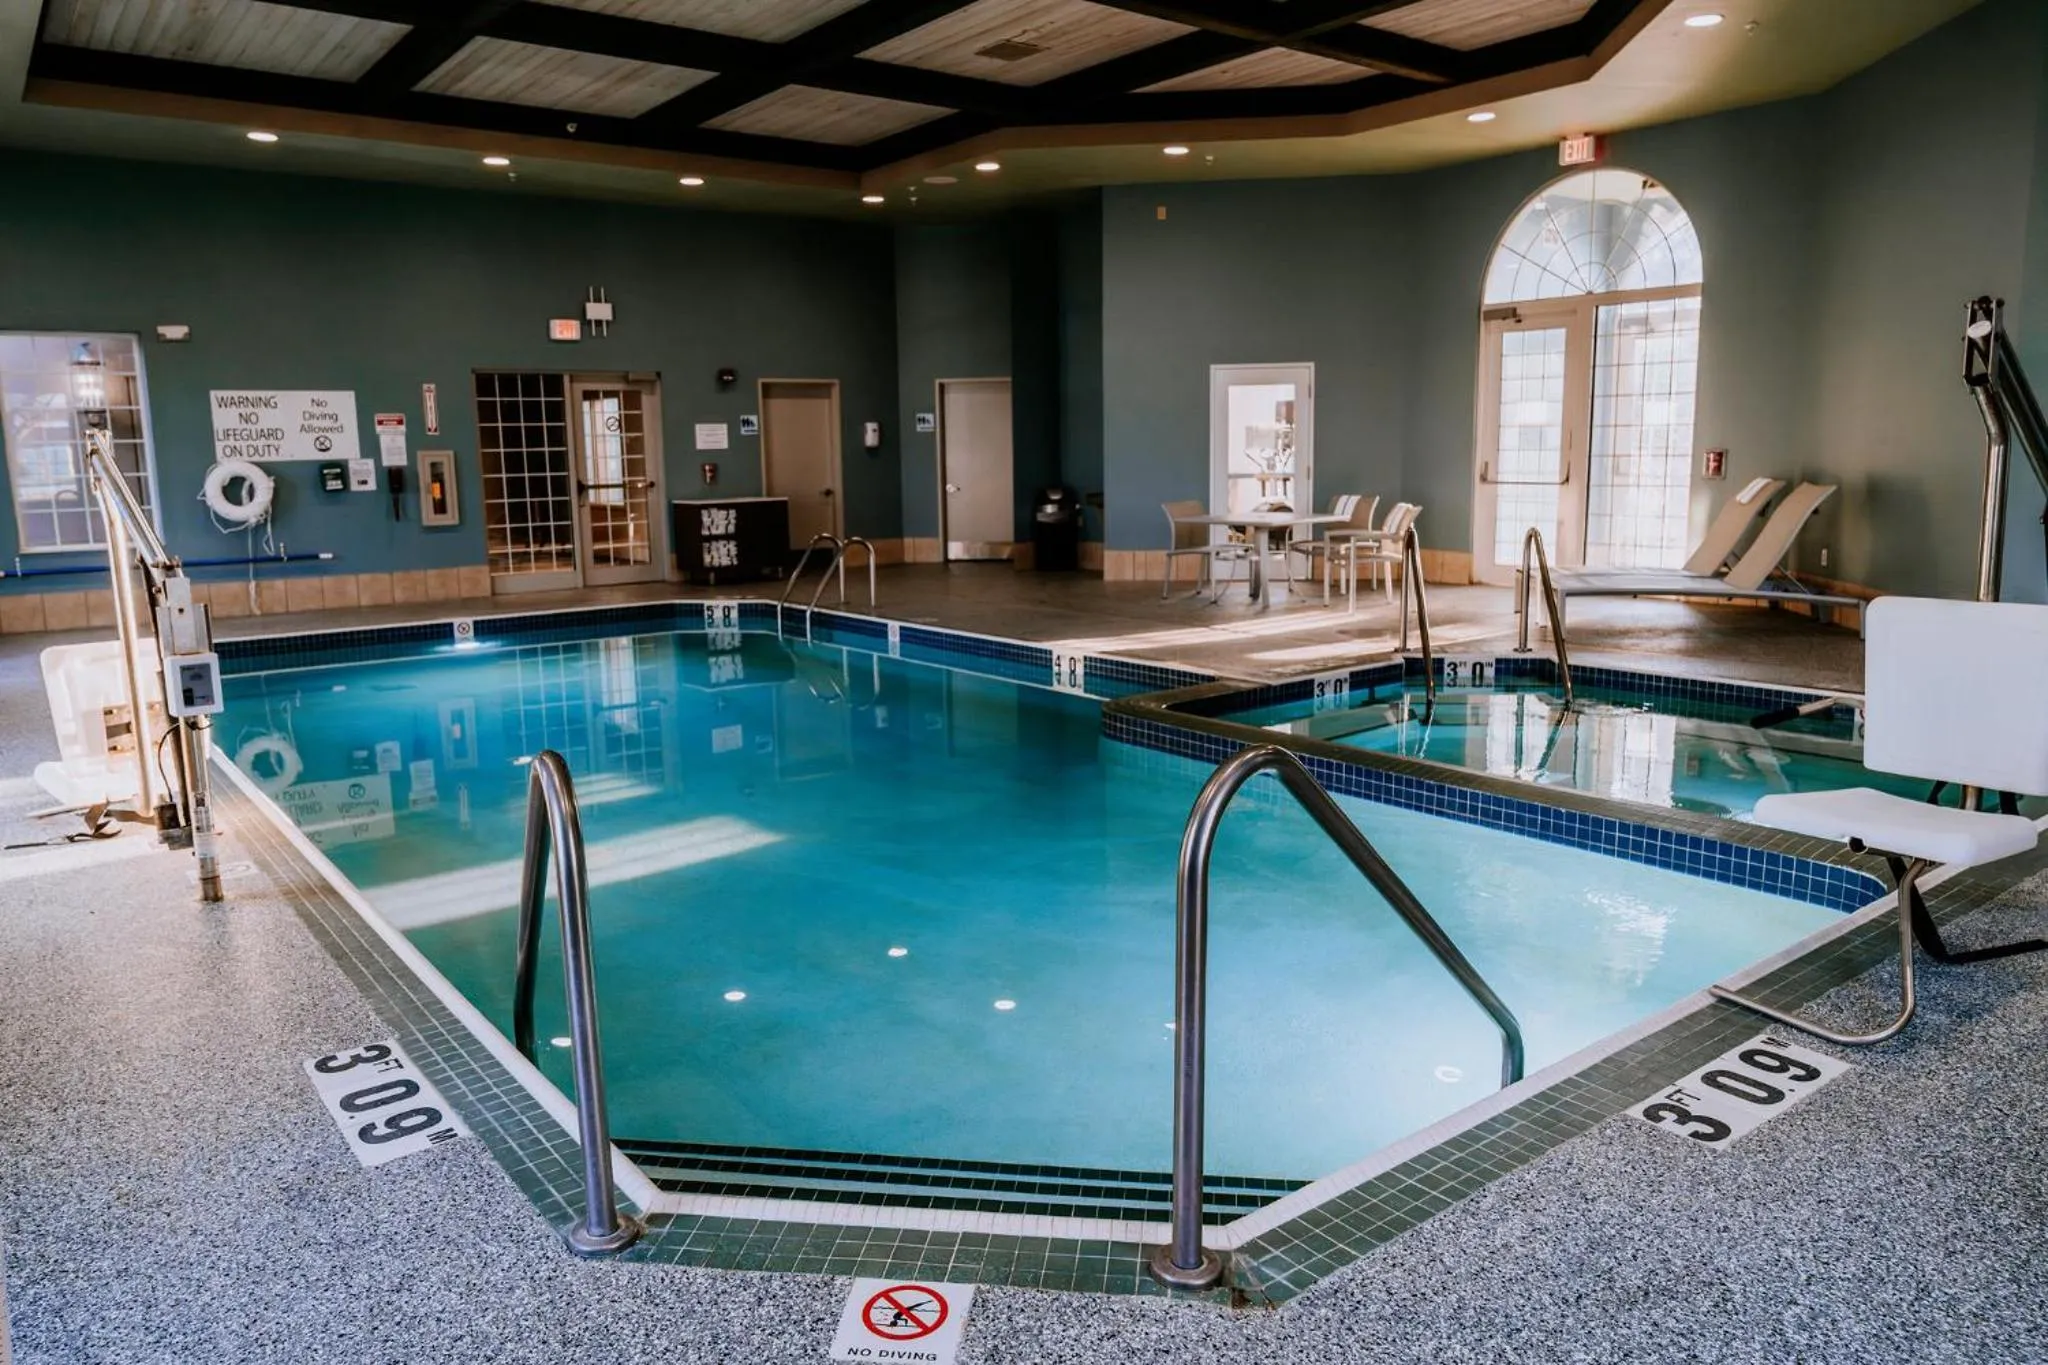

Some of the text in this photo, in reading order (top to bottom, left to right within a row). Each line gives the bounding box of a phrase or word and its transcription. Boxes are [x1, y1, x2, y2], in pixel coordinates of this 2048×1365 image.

[1565, 139, 1588, 161] EXIT
[214, 394, 278, 409] WARNING
[310, 398, 328, 408] No
[238, 412, 259, 425] NO
[302, 411, 339, 422] Diving
[216, 428, 285, 442] LIFEGUARD
[299, 424, 344, 434] Allowed
[222, 444, 281, 458] ON DUTY
[847, 1347, 938, 1361] NO DIVING
